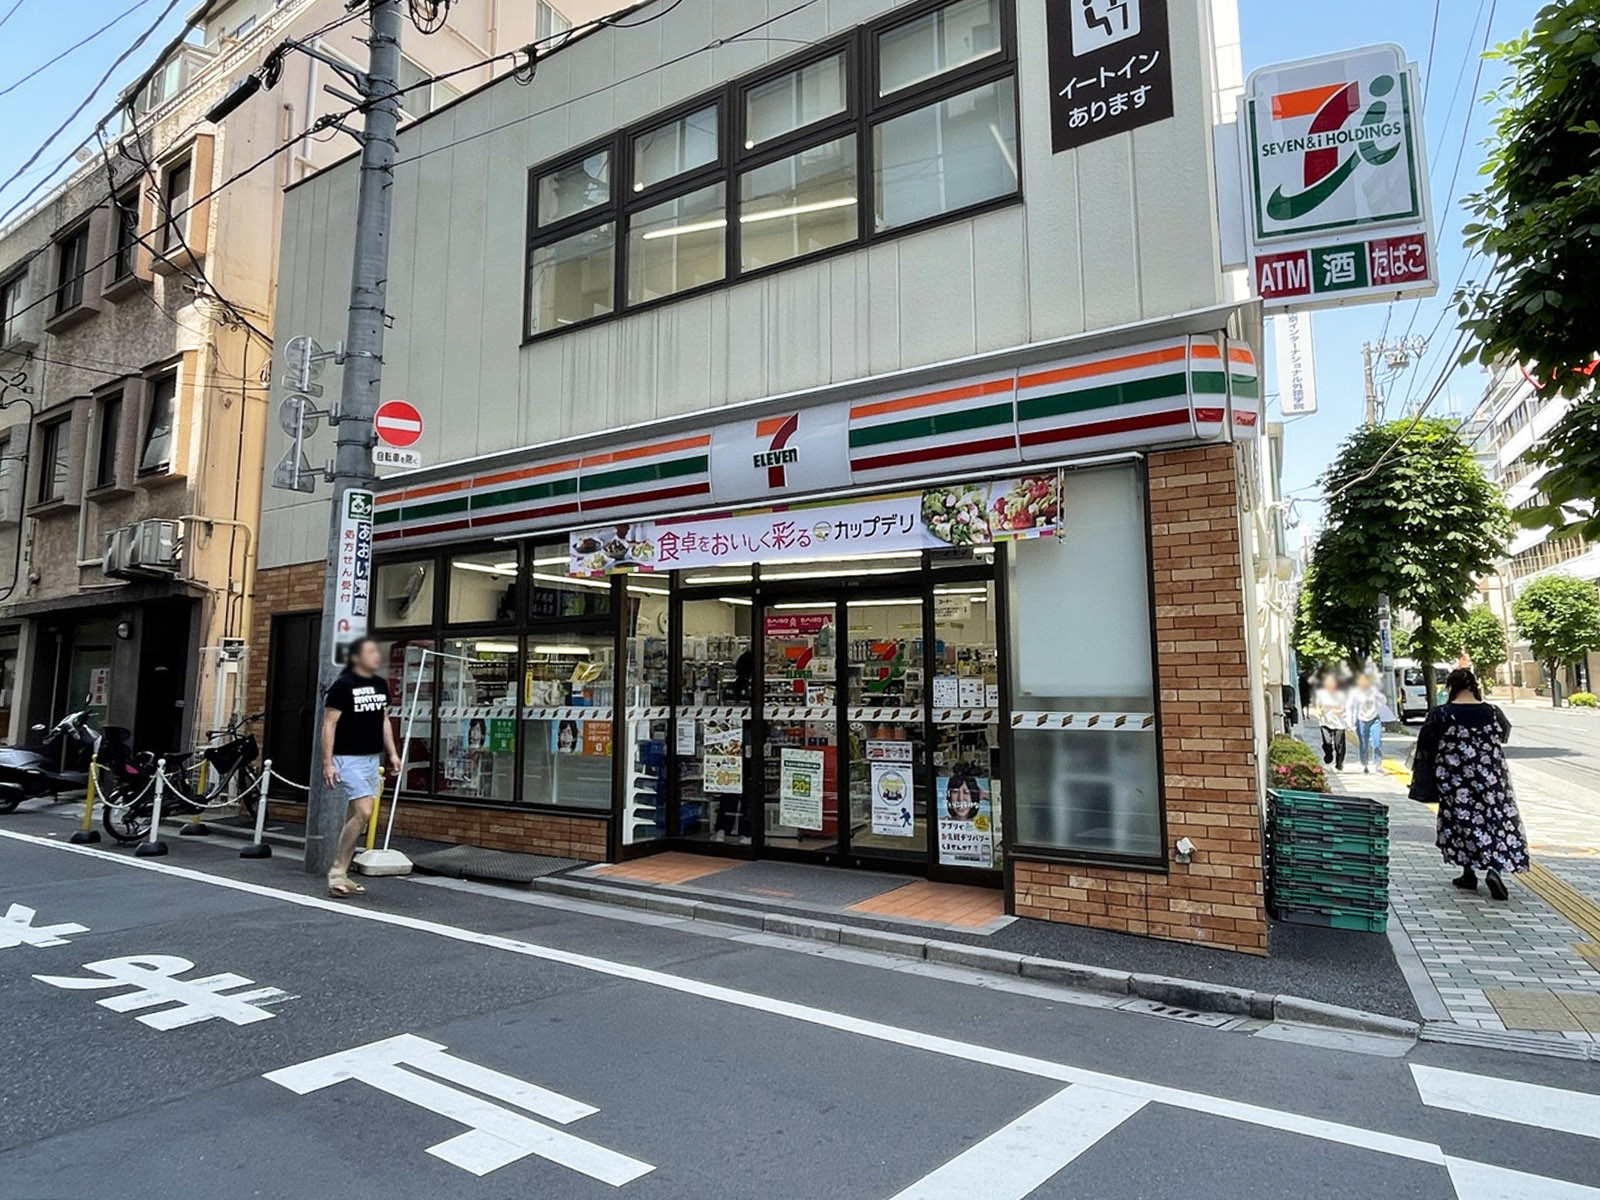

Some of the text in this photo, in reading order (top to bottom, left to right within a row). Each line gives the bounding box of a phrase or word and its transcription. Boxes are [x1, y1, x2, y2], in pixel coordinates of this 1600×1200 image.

[1058, 50, 1160, 100] イートイン
[1068, 84, 1152, 128] あります
[1326, 121, 1402, 146] HOLDINGS
[1260, 243, 1425, 293] ATM 酒 たばこ
[377, 451, 418, 465] 自転車を除く
[657, 513, 914, 562] 食卓をおいしく彩る カップデリ
[339, 529, 356, 603] 処方せん受付
[353, 524, 372, 616] あおい薬局
